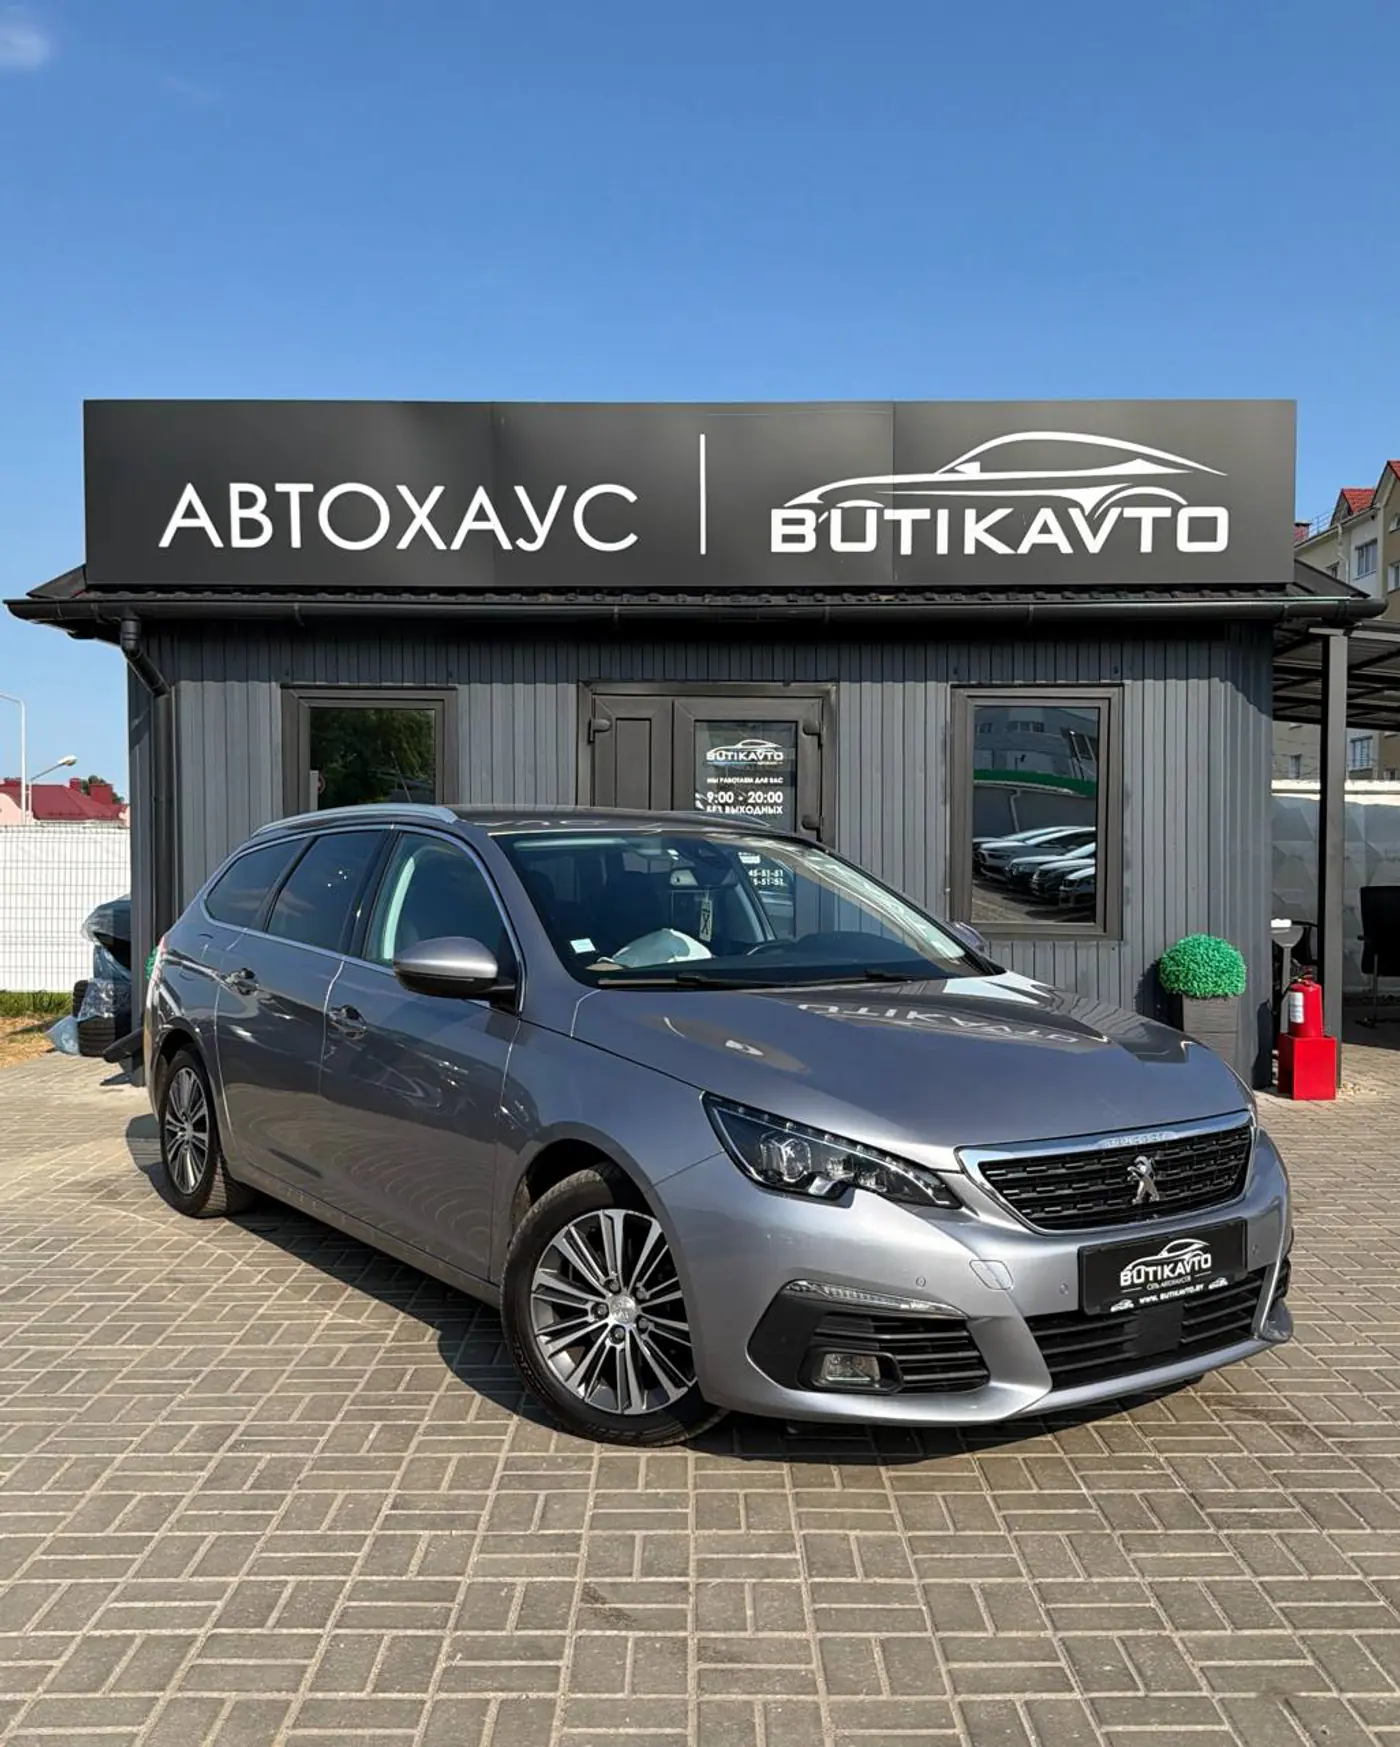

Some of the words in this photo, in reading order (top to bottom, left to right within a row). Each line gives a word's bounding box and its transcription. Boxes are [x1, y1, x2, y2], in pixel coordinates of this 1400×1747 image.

[158, 482, 638, 552] АВТОХАУС
[770, 506, 1229, 555] BUTIKAVTO
[705, 751, 784, 761] BUTIKAVTO
[706, 791, 734, 804] 9:00
[747, 790, 784, 804] 20:00
[724, 804, 784, 816] ВЫХОДНЫХ
[1120, 1253, 1212, 1287] BUTIKAVTO
